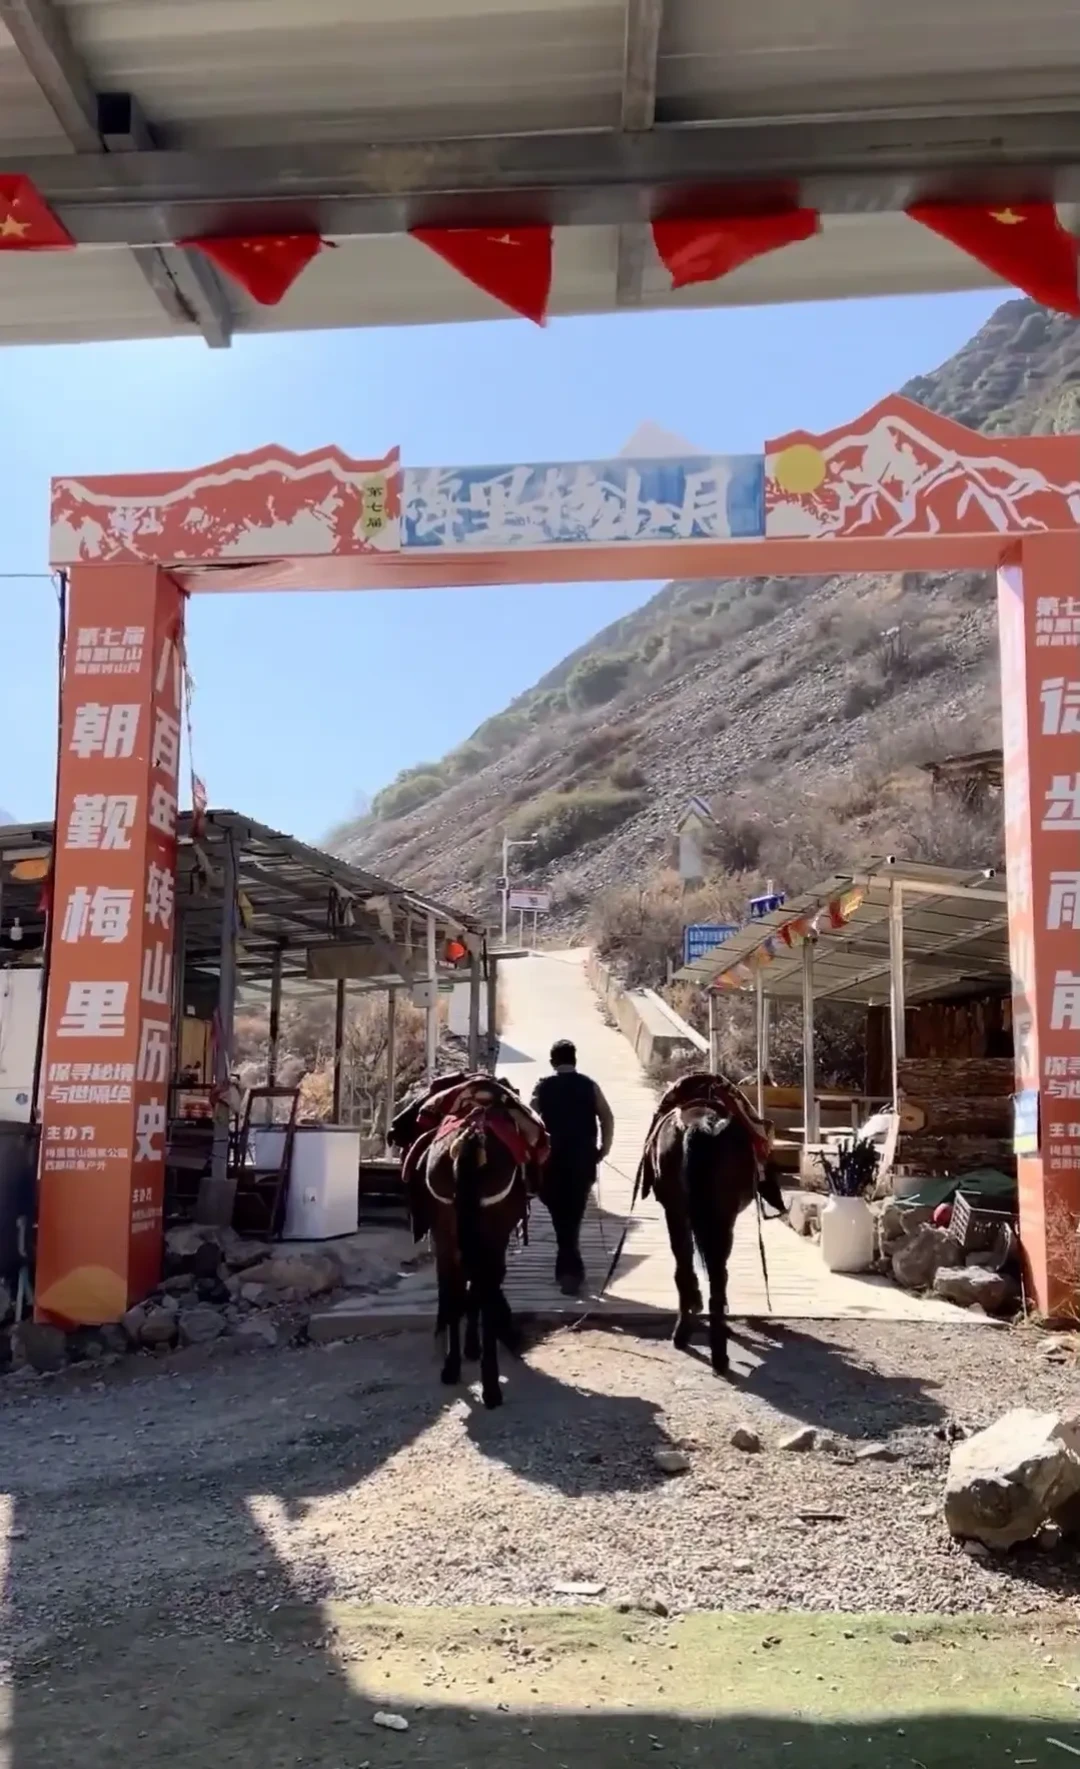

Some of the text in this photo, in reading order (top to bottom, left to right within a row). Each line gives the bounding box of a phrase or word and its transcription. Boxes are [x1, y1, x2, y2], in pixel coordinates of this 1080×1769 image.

[366, 487, 384, 528] 第七届
[77, 626, 145, 646] 第七届
[57, 702, 142, 1037] 朝觐梅里
[134, 637, 182, 1162] 八百年转山历史
[47, 1062, 135, 1081] 探寻秘境
[46, 1084, 132, 1104] 与世隔绝
[47, 1126, 95, 1141] 主办方
